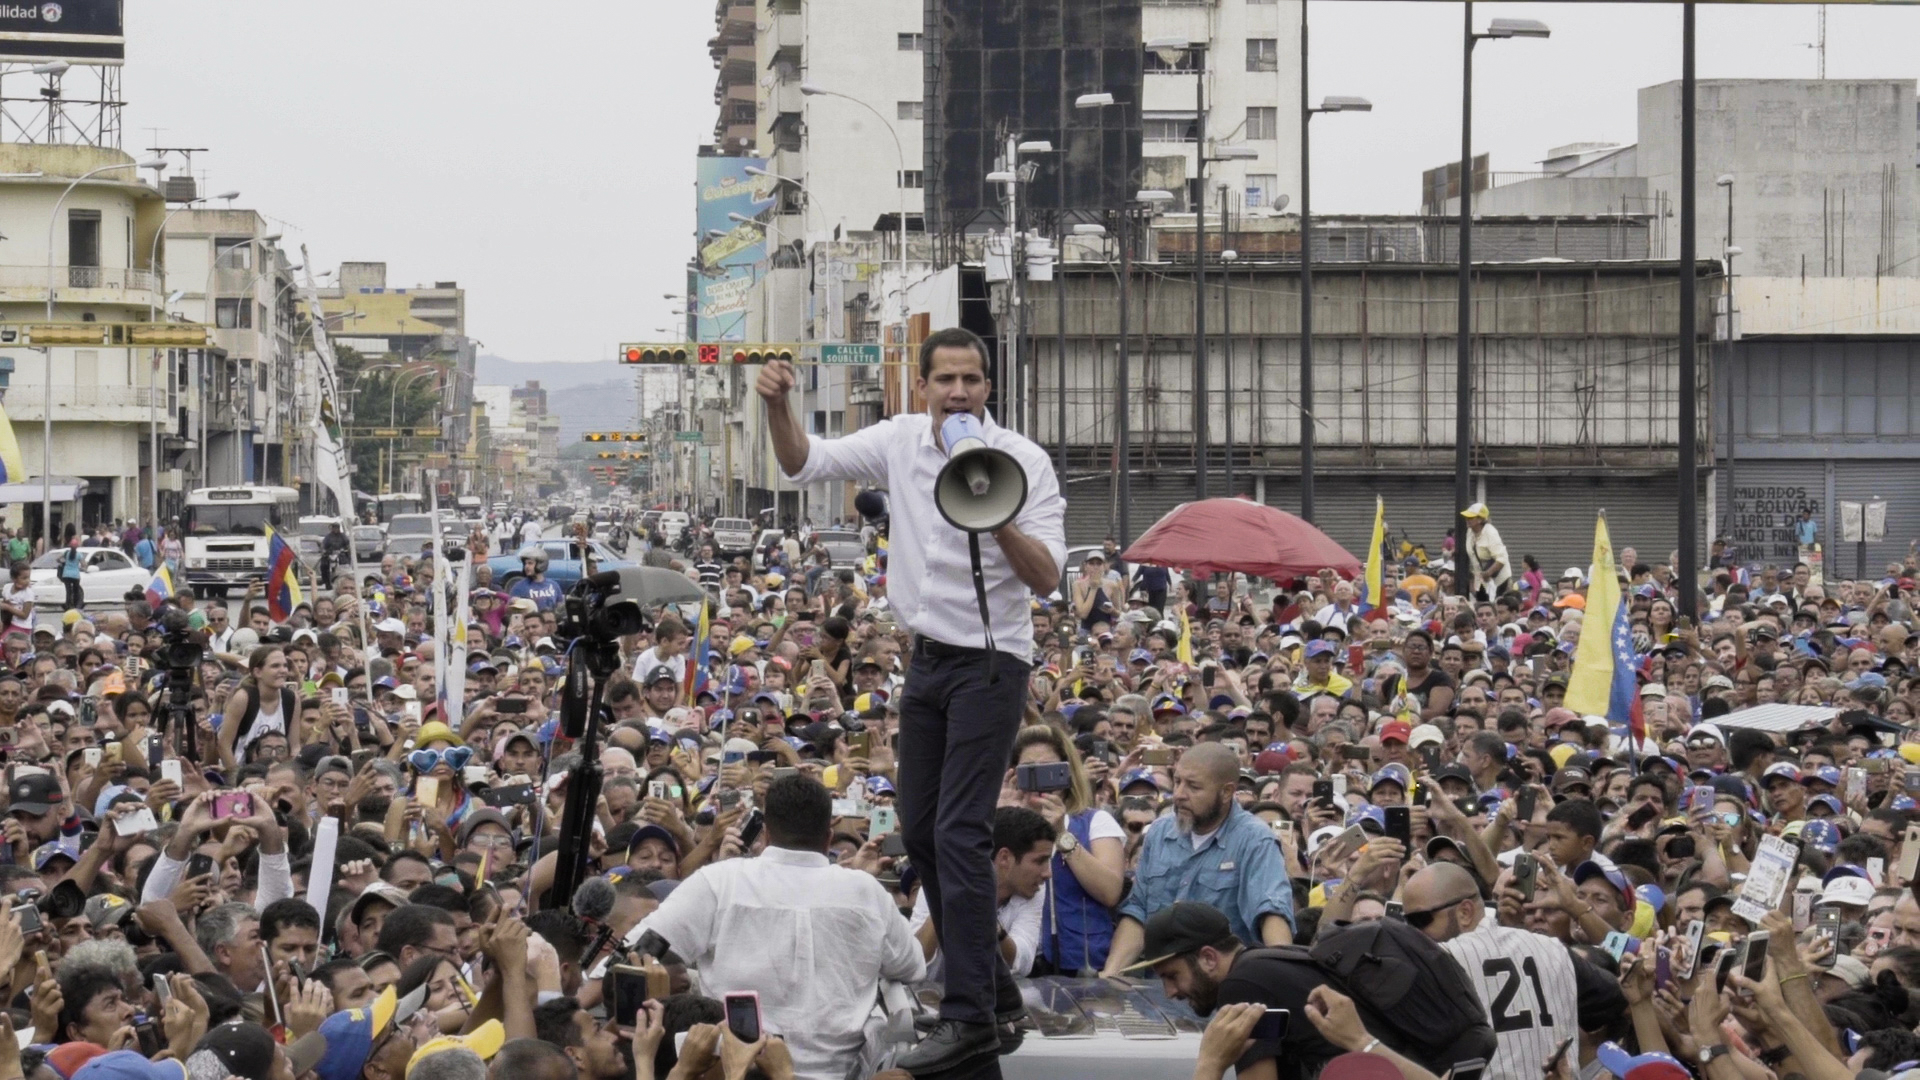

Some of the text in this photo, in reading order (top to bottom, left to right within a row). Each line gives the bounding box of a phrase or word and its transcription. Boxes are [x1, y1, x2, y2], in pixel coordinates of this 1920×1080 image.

[699, 345, 719, 363] 02
[837, 346, 865, 355] CALLE
[826, 354, 875, 363] SOUBLETTE
[1734, 486, 1807, 499] MUDADOS
[529, 584, 555, 599] ITALY
[1482, 956, 1554, 1033] 21
